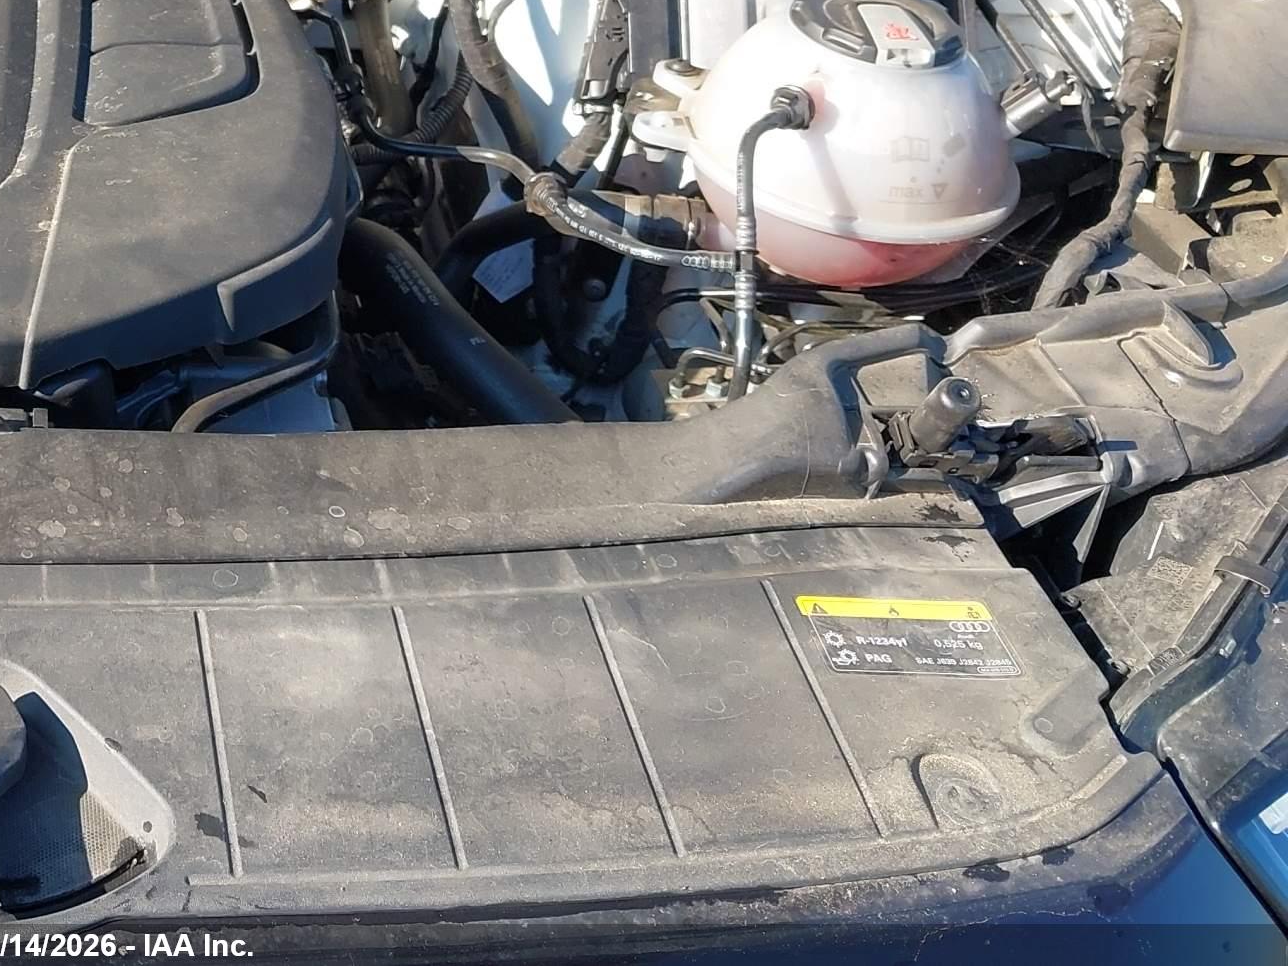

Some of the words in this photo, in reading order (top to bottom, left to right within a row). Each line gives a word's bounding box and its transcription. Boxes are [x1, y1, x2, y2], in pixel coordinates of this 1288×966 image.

[934, 639, 965, 650] 0,525
[967, 640, 984, 651] kg
[865, 653, 892, 663] PAG
[916, 657, 934, 665] SAE
